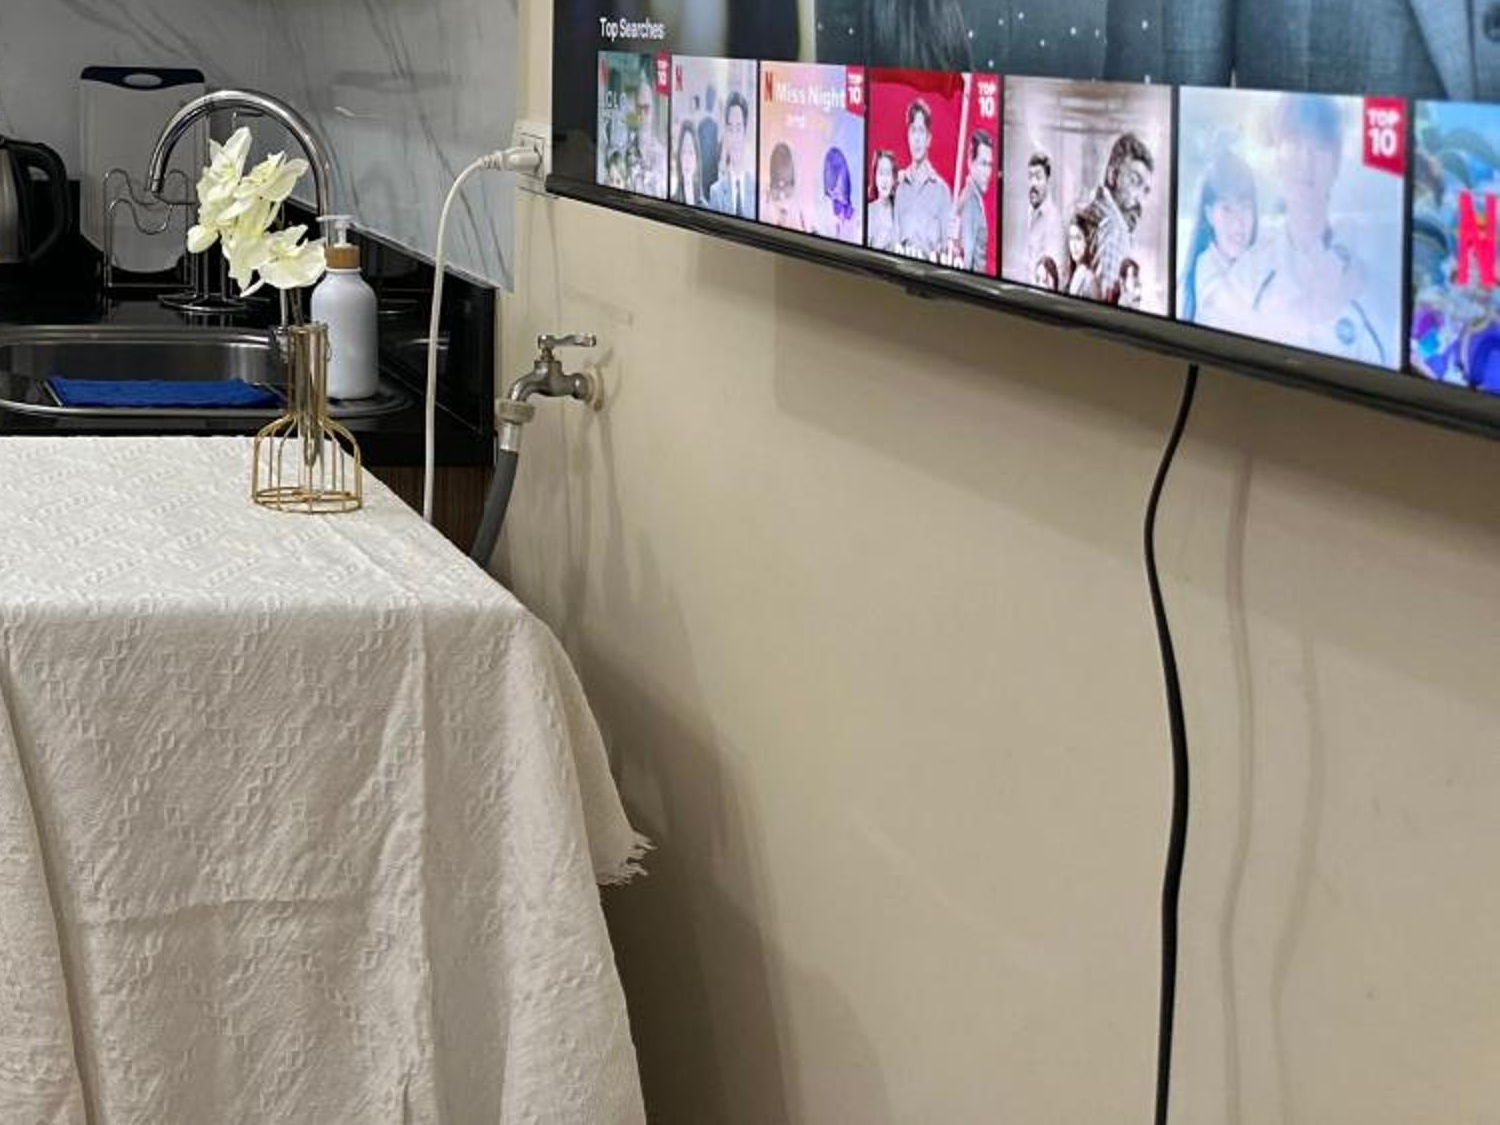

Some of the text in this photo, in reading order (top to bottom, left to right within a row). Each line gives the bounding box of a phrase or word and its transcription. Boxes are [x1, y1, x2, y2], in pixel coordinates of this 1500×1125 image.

[599, 16, 666, 43] Top Searches
[775, 81, 806, 105] Miss
[847, 85, 862, 105] 10
[977, 81, 997, 96] TOP
[978, 96, 996, 118] 10
[1367, 108, 1401, 127] TOP
[1367, 128, 1399, 157] 10
